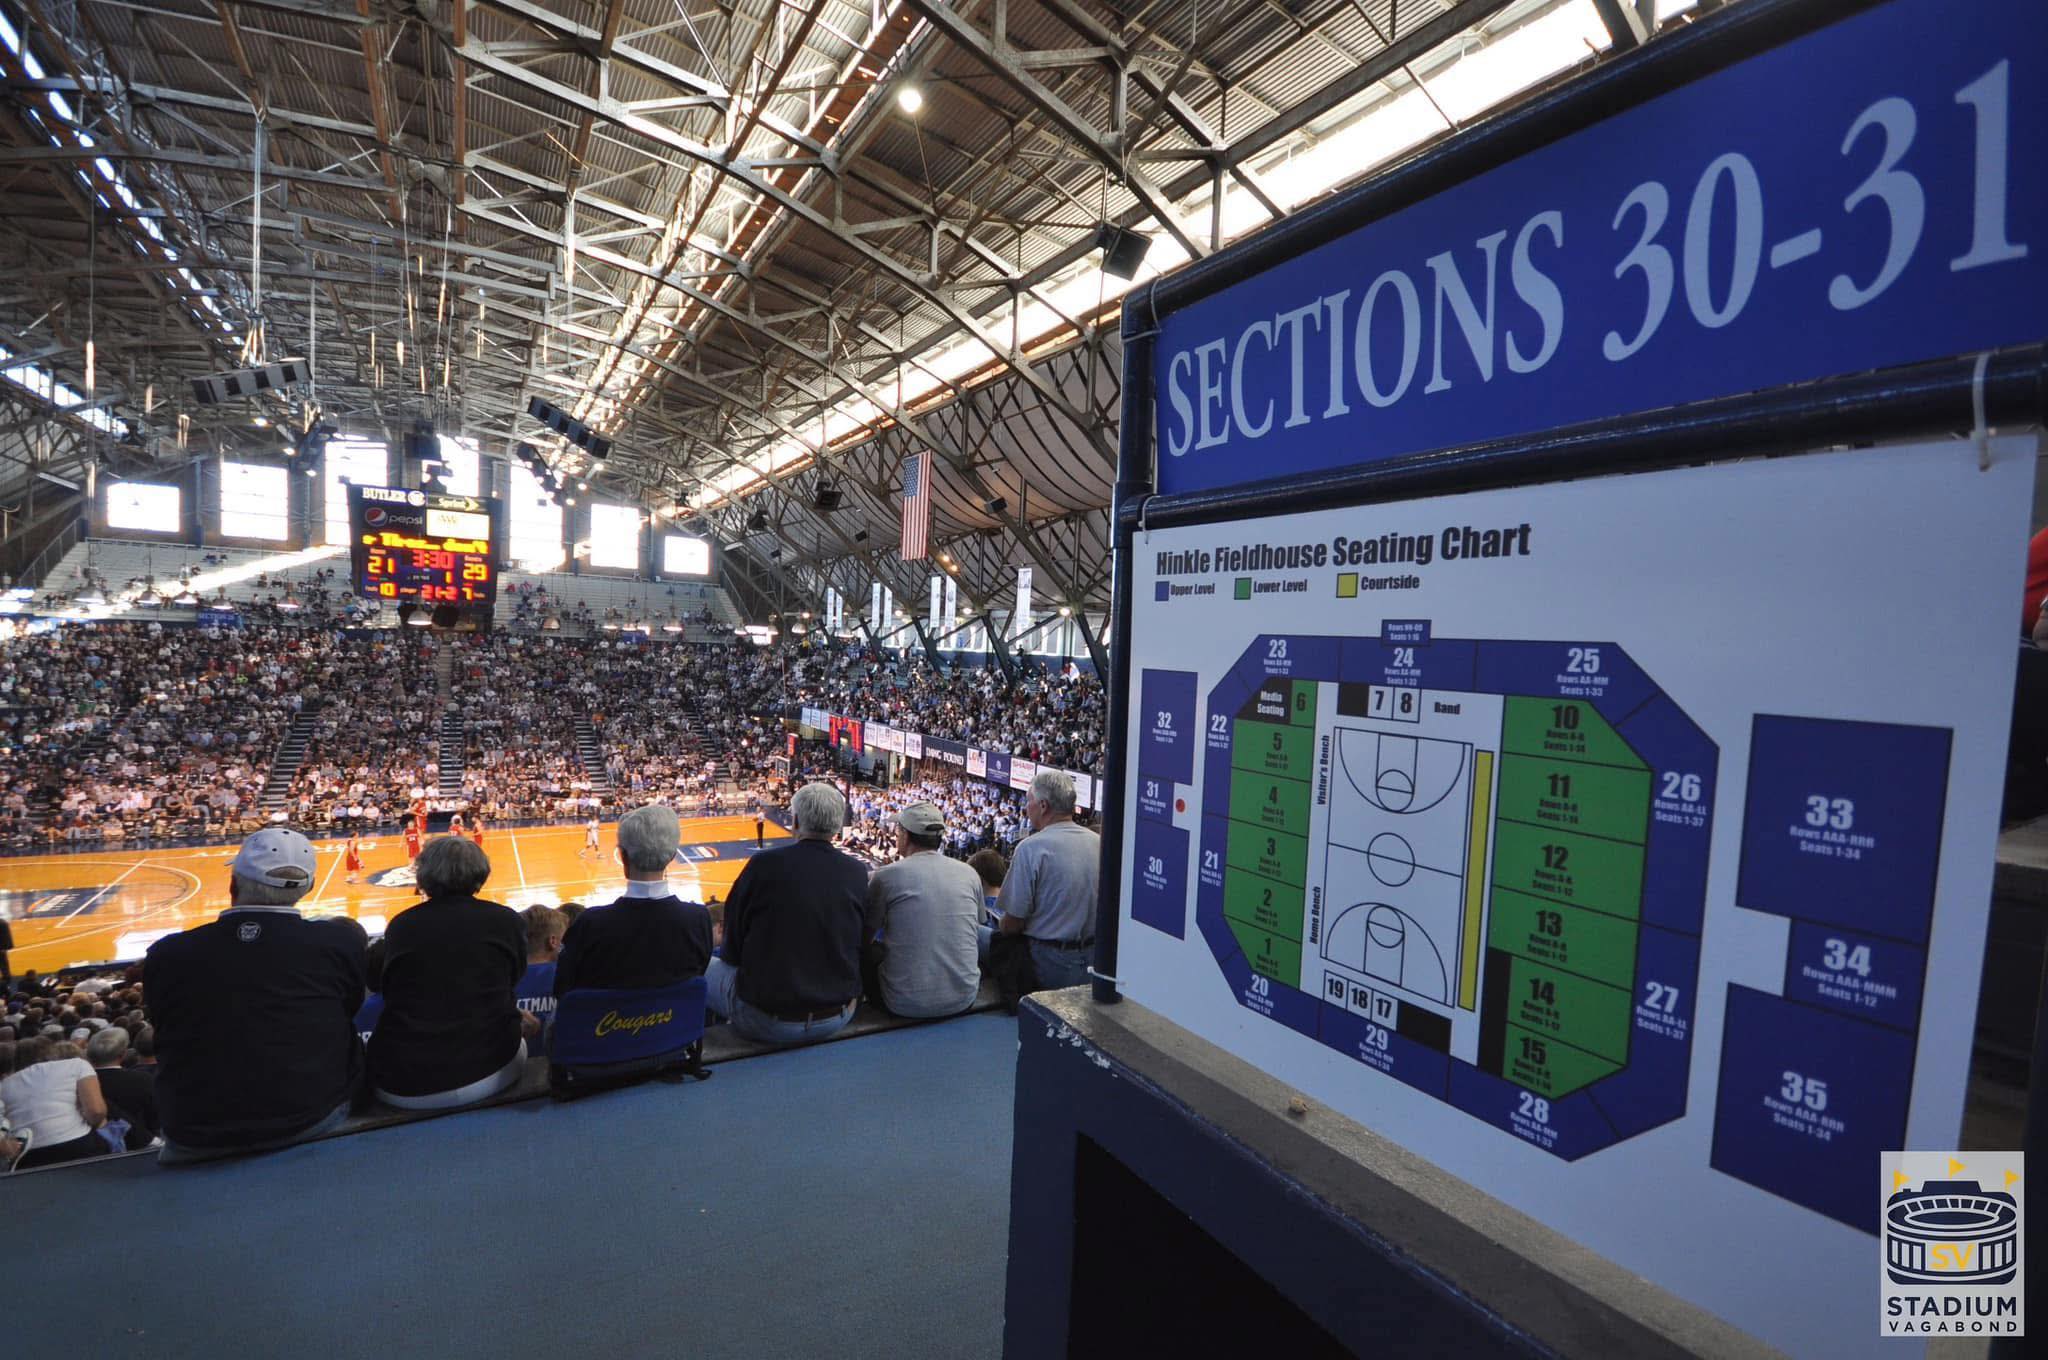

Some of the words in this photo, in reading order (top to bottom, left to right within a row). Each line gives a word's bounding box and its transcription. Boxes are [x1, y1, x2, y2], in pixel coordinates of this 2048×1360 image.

[1168, 210, 1564, 457] SECTIONS
[1603, 58, 2028, 361] 30-31
[362, 487, 407, 503] BUTLER
[388, 514, 423, 526] pepsi
[1156, 550, 1211, 576] Hinkle
[1214, 543, 1327, 572] Fieldhouse
[1333, 533, 1434, 565] Seating
[1441, 523, 1532, 560] Chart
[1170, 584, 1192, 596] Upper
[1194, 583, 1215, 595] Level
[1253, 580, 1281, 593] Lower
[1282, 579, 1308, 592] Level
[1361, 574, 1420, 591] Courtside
[1268, 639, 1287, 658] 23
[1393, 647, 1414, 667] 24
[1566, 648, 1600, 674] 25
[1557, 674, 1578, 684] Rows
[1260, 690, 1282, 702] Media
[1560, 685, 1584, 695] Seats
[1296, 692, 1306, 712] 6
[1376, 690, 1384, 710] 7
[1400, 692, 1412, 713] 8
[1434, 702, 1461, 715] Band
[1158, 711, 1172, 729] 32
[1257, 704, 1285, 717] Seating
[1552, 704, 1579, 730] 10
[1211, 714, 1228, 733] 22
[1272, 732, 1282, 751] 5
[1147, 780, 1159, 799] 31
[1269, 786, 1278, 804] 4
[1548, 773, 1570, 798] 11
[1662, 771, 1702, 802] 26
[1654, 799, 1680, 810] Rows
[1806, 796, 1854, 830] 33
[1655, 810, 1682, 824] Seats
[1790, 826, 1820, 840] Rows
[1266, 838, 1275, 856] 3
[1800, 840, 1832, 855] Seats
[1836, 847, 1861, 860] 1-34
[1148, 856, 1162, 875] 30
[1204, 850, 1218, 870] 21
[1541, 844, 1568, 871] 12
[1264, 888, 1272, 906] 2
[1536, 910, 1562, 936] 13
[1264, 938, 1271, 955] 1
[1824, 938, 1871, 977] 34
[1803, 966, 1835, 982] Rows
[1251, 974, 1269, 997] 20
[1328, 978, 1344, 1000] 19
[1530, 978, 1555, 1006] 14
[1352, 988, 1369, 1009] 18
[1644, 982, 1680, 1014] 27
[1818, 983, 1852, 1001] Seats
[1855, 993, 1878, 1008] 1-12
[1376, 998, 1392, 1020] 17
[1636, 1006, 1661, 1022] Rows
[595, 1008, 673, 1037] Cougars
[1637, 1018, 1664, 1034] Seats
[1366, 1024, 1388, 1051] 29
[1520, 1036, 1546, 1064] 15
[1782, 1071, 1828, 1111] 35
[1519, 1091, 1550, 1124] 28
[1764, 1096, 1793, 1114] Rows
[1510, 1111, 1530, 1127] Rows
[1774, 1112, 1805, 1132] Seats
[1808, 1124, 1832, 1142] 1-34
[1513, 1123, 1535, 1140] Seats
